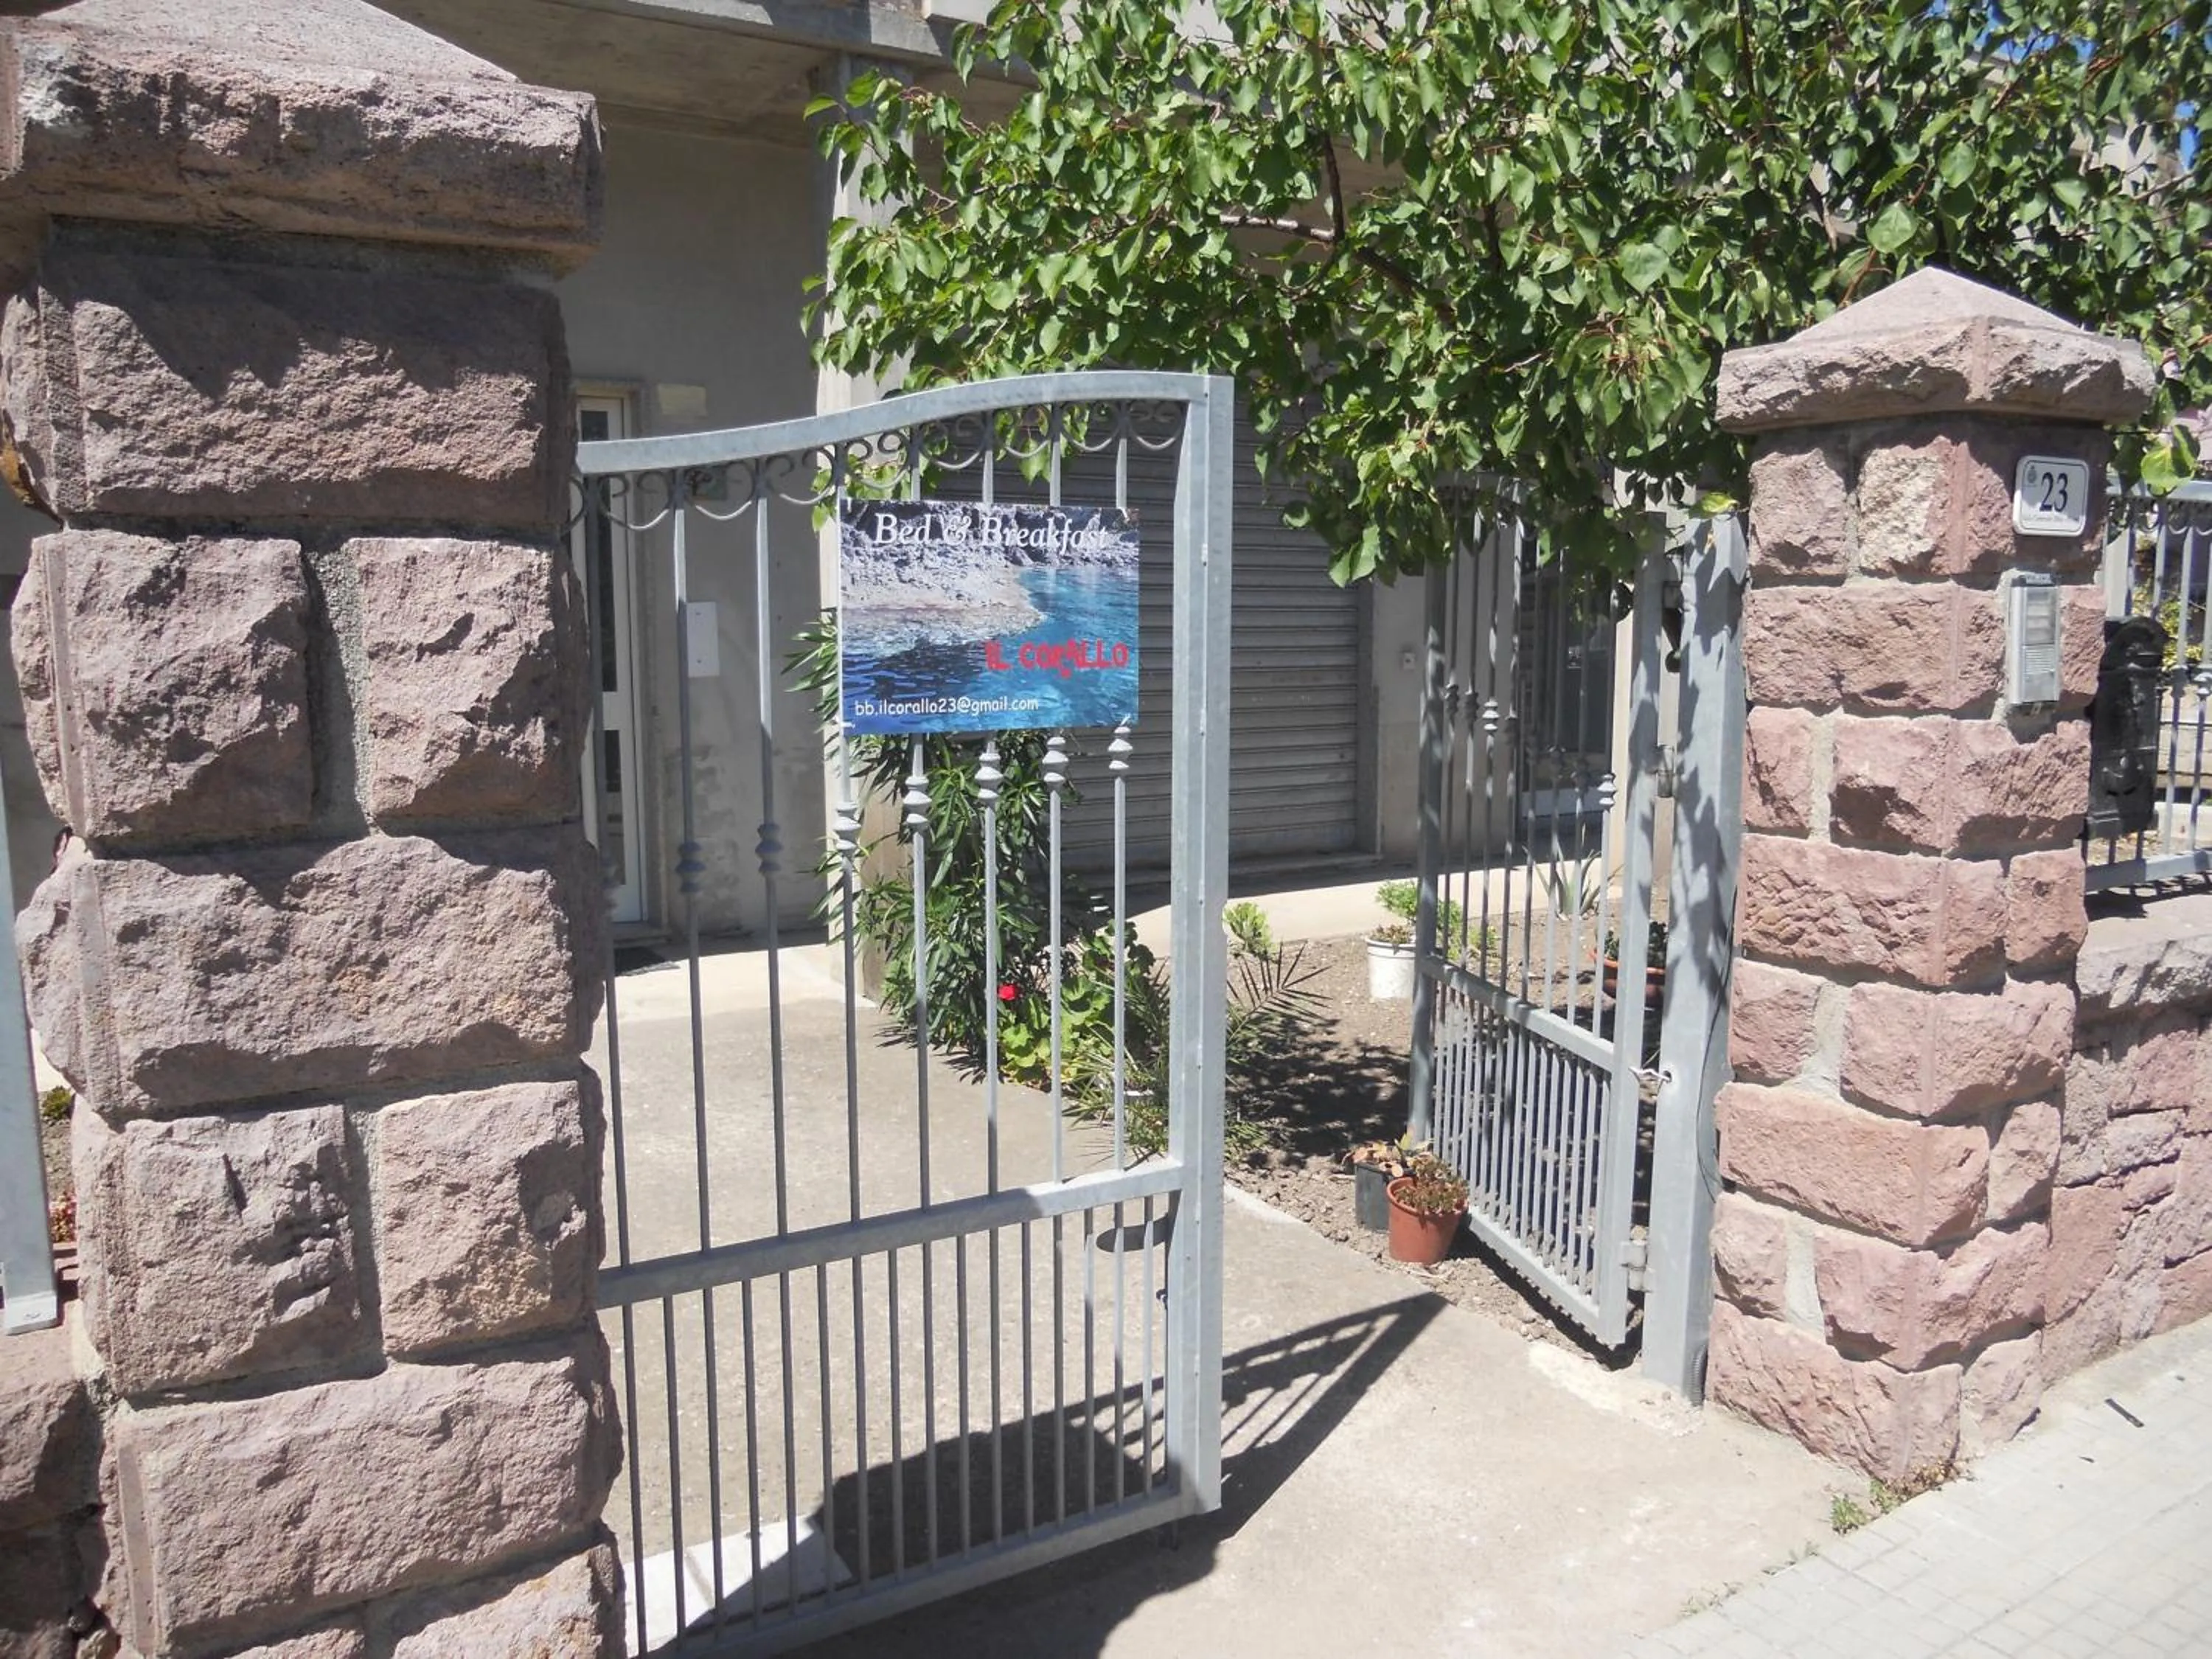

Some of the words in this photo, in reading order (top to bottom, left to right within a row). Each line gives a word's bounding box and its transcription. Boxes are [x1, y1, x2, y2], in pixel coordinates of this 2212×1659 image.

[2039, 472, 2068, 512] 23
[874, 512, 931, 545] Bed
[942, 515, 973, 546] &
[981, 515, 1108, 554] Breakfast
[984, 639, 1012, 672] IL
[855, 695, 1040, 717] bb.ilcorallo23@gmail.com
